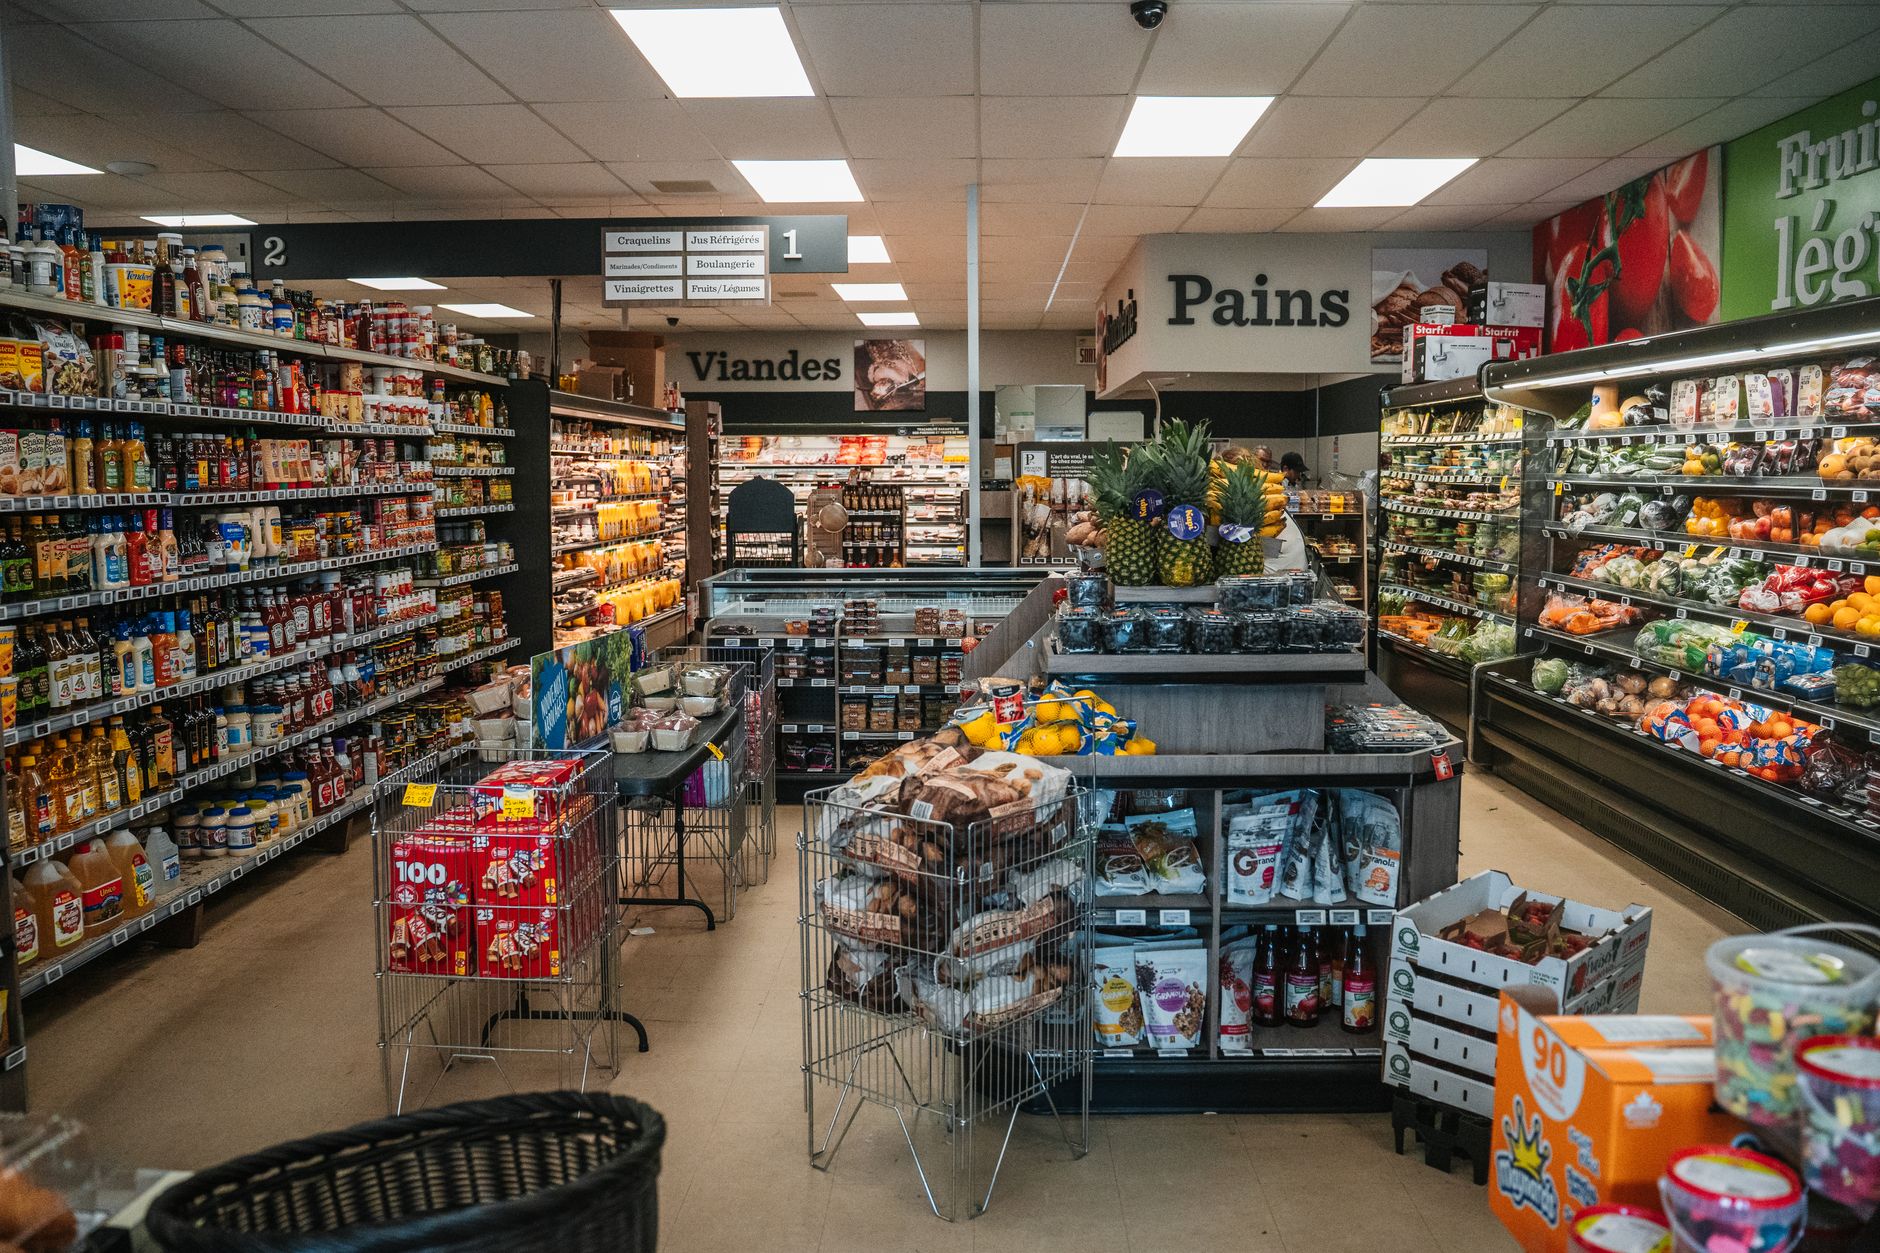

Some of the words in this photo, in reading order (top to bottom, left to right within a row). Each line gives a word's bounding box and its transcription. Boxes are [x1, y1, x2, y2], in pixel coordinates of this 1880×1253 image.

[617, 236, 671, 246] Craquelins
[691, 235, 708, 245] Jus
[710, 234, 760, 246] Réfrigérés
[783, 229, 802, 259] 1
[264, 236, 288, 266] 2
[696, 259, 755, 270] Boulangerie
[613, 284, 674, 294] Vinaigrettes
[1168, 273, 1350, 327] Pains
[1485, 328, 1519, 337] Starfrit
[686, 350, 841, 381] Viandes
[22, 437, 44, 449] Shake
[1185, 509, 1197, 531] Kapi
[395, 861, 448, 885] 100
[100, 886, 117, 897] Unico
[1533, 1026, 1567, 1089] 90
